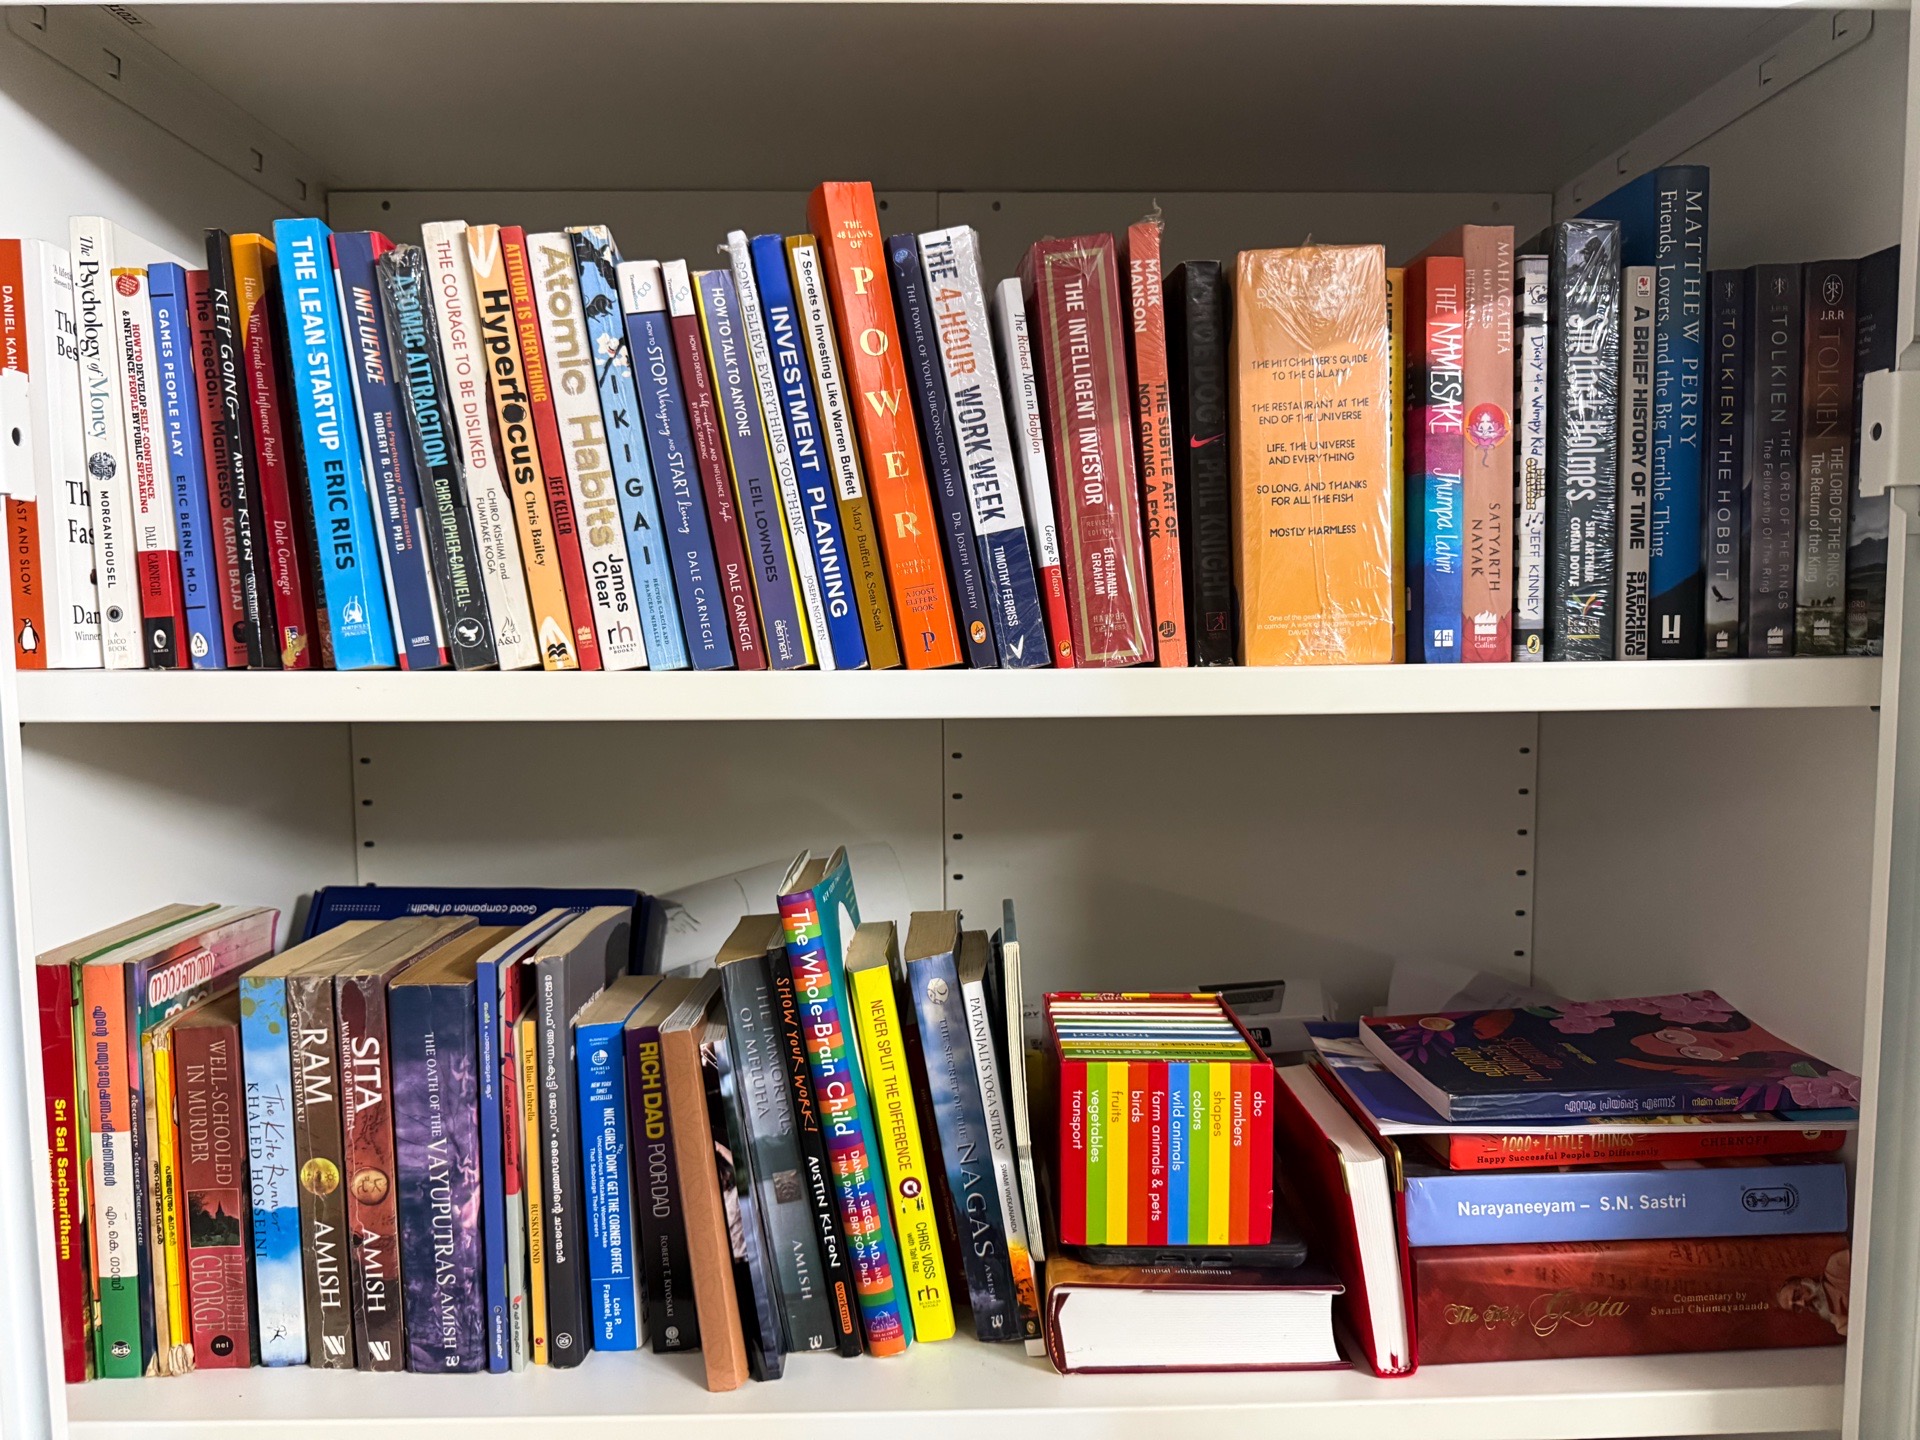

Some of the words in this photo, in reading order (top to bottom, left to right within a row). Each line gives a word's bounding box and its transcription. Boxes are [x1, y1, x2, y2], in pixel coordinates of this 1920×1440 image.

[843, 221, 863, 229] THE
[292, 236, 318, 281] THE
[924, 236, 958, 283] THE
[1682, 189, 1703, 344] MATTHEW
[244, 277, 256, 299] How
[907, 283, 916, 302] THE
[1065, 280, 1084, 312] THE
[1130, 259, 1147, 332] MANSON
[1145, 259, 1159, 306] MARK
[1435, 287, 1457, 315] THE
[1497, 241, 1511, 355] MAHAGATHA
[247, 301, 255, 311] to
[249, 314, 258, 334] Win
[298, 288, 326, 346] LEAN
[911, 306, 922, 337] POWER
[1014, 311, 1026, 332] The
[1821, 310, 1844, 321] J.R.R
[159, 309, 172, 357] GAMES
[918, 338, 926, 358] OF
[934, 288, 979, 377] 4-HOUR
[252, 336, 266, 370] Friends
[1017, 335, 1030, 370] Richest
[1068, 319, 1096, 421] INTELLIGENT
[1770, 314, 1788, 423] TOLKIEN
[164, 363, 179, 417] PEOPLE
[256, 371, 267, 389] and
[921, 358, 933, 388] YOUR
[1022, 374, 1034, 397] Man
[1428, 322, 1462, 435] NAMESAKE
[1720, 318, 1735, 426] TOLKIEN
[258, 389, 271, 436] Influence
[308, 352, 340, 451] STARTUP
[539, 245, 590, 396] Atomic
[567, 414, 616, 548] Habits
[1026, 400, 1034, 410] in
[1680, 357, 1699, 449] PERRY
[927, 390, 948, 465] SUBCONSCIOUS
[955, 385, 993, 456] WORK
[1027, 413, 1044, 454] Babylon
[170, 423, 183, 457] PLAY
[262, 437, 276, 467] People
[1269, 456, 1290, 465] AND
[1293, 452, 1355, 464] EVERYTHING
[1718, 434, 1732, 480] THE
[1780, 429, 1792, 457] THE
[770, 306, 820, 472] INVESTMENT
[806, 487, 847, 618] PLANNING
[1079, 426, 1103, 506] INVESTOR
[176, 475, 188, 507] ERIC
[324, 460, 348, 512] ERIC
[943, 468, 954, 497] MIND
[968, 457, 1006, 524] WEEK
[1779, 463, 1791, 501] LORD
[100, 490, 113, 540] MORGAN
[852, 506, 863, 532] Mary
[1270, 527, 1306, 538] MOSTLY
[1308, 525, 1357, 536] HARMLESS
[1779, 506, 1790, 527] OF
[18, 526, 28, 554] AND
[180, 513, 193, 563] BERNE,
[331, 519, 355, 570] RIES
[487, 488, 499, 522] ICHIRO
[493, 524, 506, 560] KISHIMI
[500, 562, 510, 580] and
[857, 535, 870, 568] Buffett
[1489, 502, 1501, 591] SATYARTH
[1715, 490, 1731, 580] HOBBIT
[1778, 531, 1789, 557] THE
[20, 559, 32, 596] SLOW
[104, 543, 117, 589] HOUSEL
[186, 568, 197, 596] M.D.
[608, 554, 628, 612] James
[687, 551, 702, 582] DALE
[864, 570, 874, 579] &
[866, 583, 877, 606] Sean
[1778, 564, 1789, 610] RINGS
[694, 588, 715, 650] CARNEGIE
[871, 608, 882, 632] Seah
[1625, 572, 1637, 656] HAWKING
[1635, 571, 1647, 656] STEPHEN
[412, 636, 430, 644] HARPER
[1474, 635, 1497, 643] Harper
[791, 908, 813, 947] The
[290, 1013, 299, 1046] SCION
[800, 951, 838, 1077] Whole-Brain
[871, 999, 888, 1038] NEVER
[939, 1018, 949, 1041] THE
[292, 1050, 300, 1062] OF
[424, 1032, 435, 1056] THE
[525, 1048, 533, 1064] The
[878, 1040, 895, 1071] SPLIT
[300, 1028, 333, 1105] RAM
[351, 1037, 383, 1114] SITA
[426, 1058, 438, 1088] OATH
[526, 1065, 534, 1084] Blue
[639, 1042, 662, 1089] RICH
[944, 1042, 959, 1091] SECRET
[294, 1064, 305, 1123] IKSHVAKU
[429, 1089, 440, 1110] OF
[527, 1085, 536, 1122] Umbrella
[883, 1074, 899, 1098] THE
[953, 1094, 962, 1111] OF
[55, 1099, 66, 1121] Sri
[209, 1039, 232, 1186] WELL-SCHOOLED
[430, 1112, 442, 1137] THE
[643, 1092, 665, 1139] DAD
[826, 1081, 855, 1137] Child
[1069, 1089, 1083, 1150] transport
[1111, 1090, 1124, 1123] fruits
[1234, 1091, 1246, 1147] numbers
[56, 1126, 68, 1153] Sai
[889, 1101, 912, 1171] DIFFERENCE
[958, 1113, 968, 1139] THE
[1087, 1089, 1104, 1163] vegetables
[1501, 1136, 1540, 1152] 1000+
[1544, 1134, 1584, 1150] LITTLE
[1589, 1133, 1634, 1149] THINGS
[648, 1144, 668, 1184] POOR
[1477, 1155, 1505, 1164] Happy
[1509, 1152, 1557, 1162] Successful
[1560, 1150, 1590, 1160] People
[1593, 1150, 1605, 1158] Do
[1609, 1148, 1658, 1157] Differently
[57, 1157, 70, 1260] Sacharitham
[427, 1137, 457, 1285] VAYUPUTRAS
[651, 1185, 671, 1218] DAD
[957, 1143, 995, 1258] NAGAS
[660, 1235, 669, 1267] ROBERT
[792, 1240, 813, 1300] AMISH
[191, 1255, 225, 1333] GEORGE
[603, 1284, 612, 1320] Frankel,
[664, 1278, 674, 1317] KIYOSAKI
[1651, 1304, 1684, 1316] Swami
[1688, 1301, 1769, 1313] Chinmayananda
[1673, 1293, 1732, 1303] Commentary
[1736, 1291, 1747, 1301] by
[441, 1292, 457, 1349] AMISH
[605, 1321, 613, 1340] PhD
[1443, 1303, 1478, 1325] The
[1528, 1290, 1630, 1337] Geeta
[111, 1345, 130, 1355] dcb
